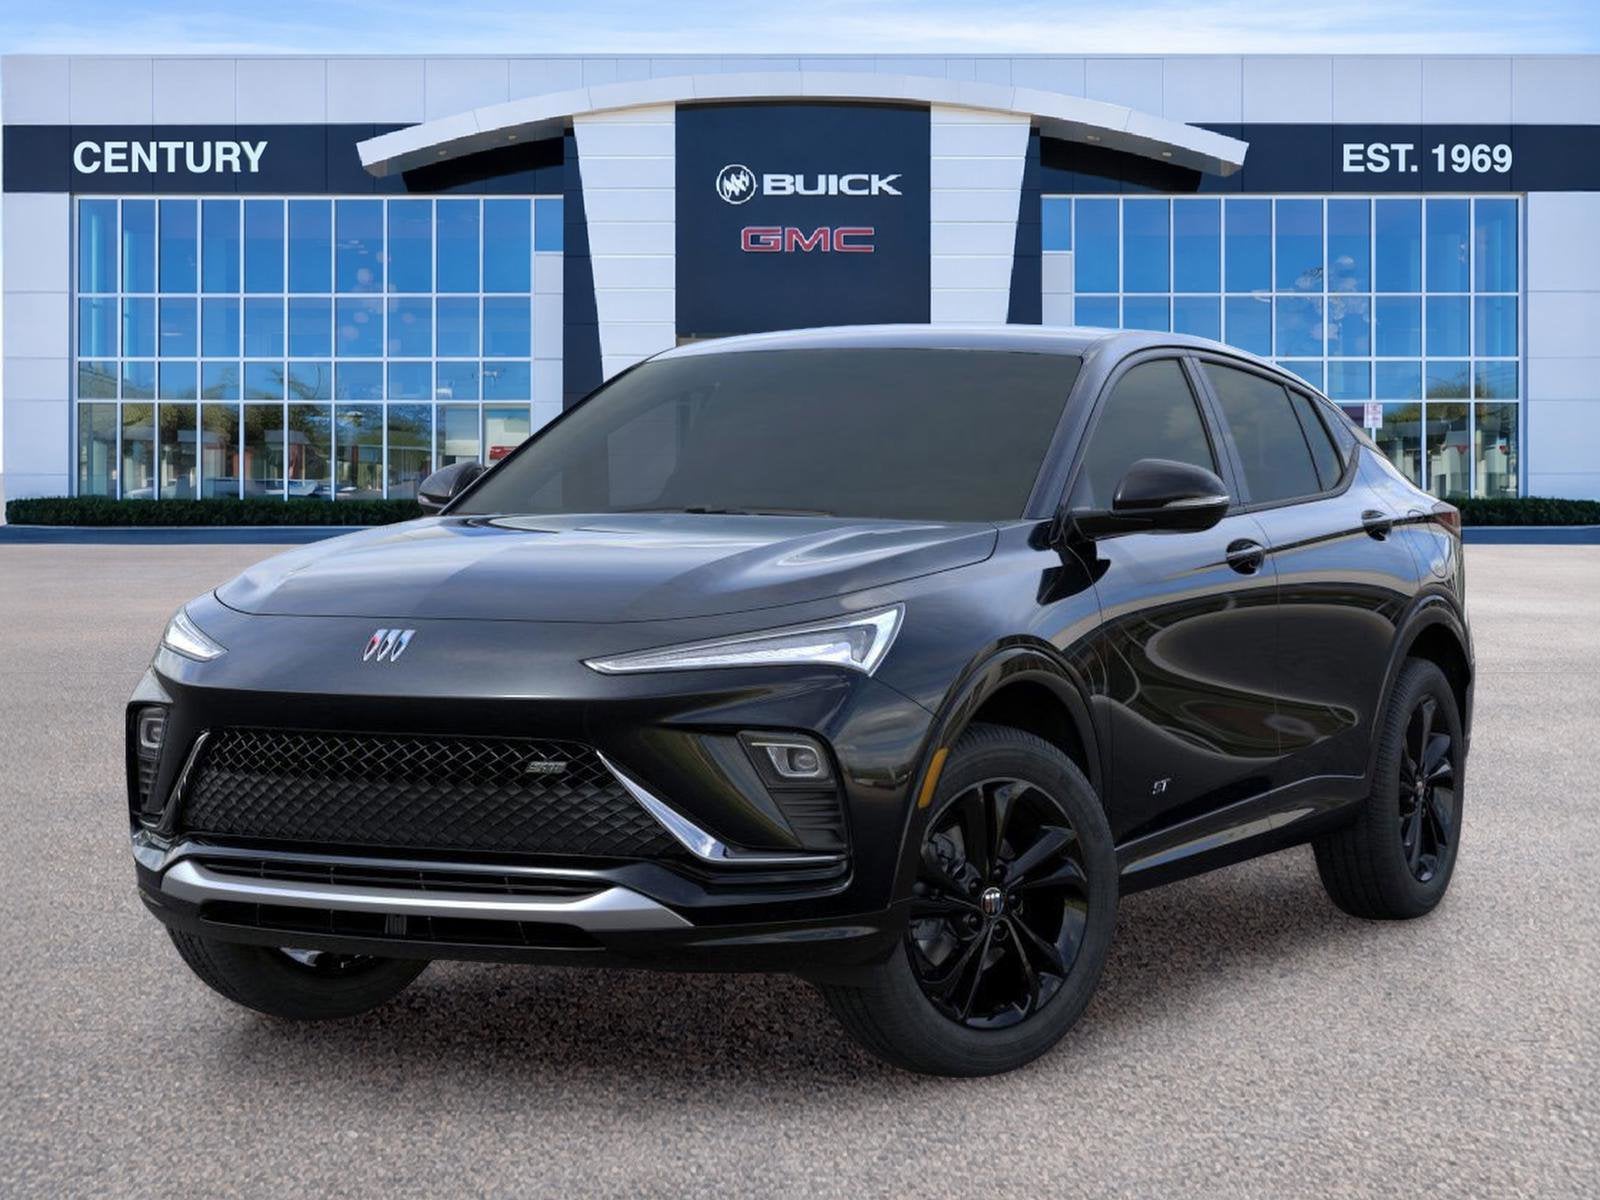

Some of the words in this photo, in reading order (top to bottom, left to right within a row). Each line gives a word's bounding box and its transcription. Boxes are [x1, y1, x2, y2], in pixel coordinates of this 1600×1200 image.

[73, 140, 268, 174] CENTURY
[1342, 143, 1418, 173] EST.
[1431, 143, 1513, 173] 1969
[762, 173, 903, 196] BUICK
[741, 226, 875, 253] GMC
